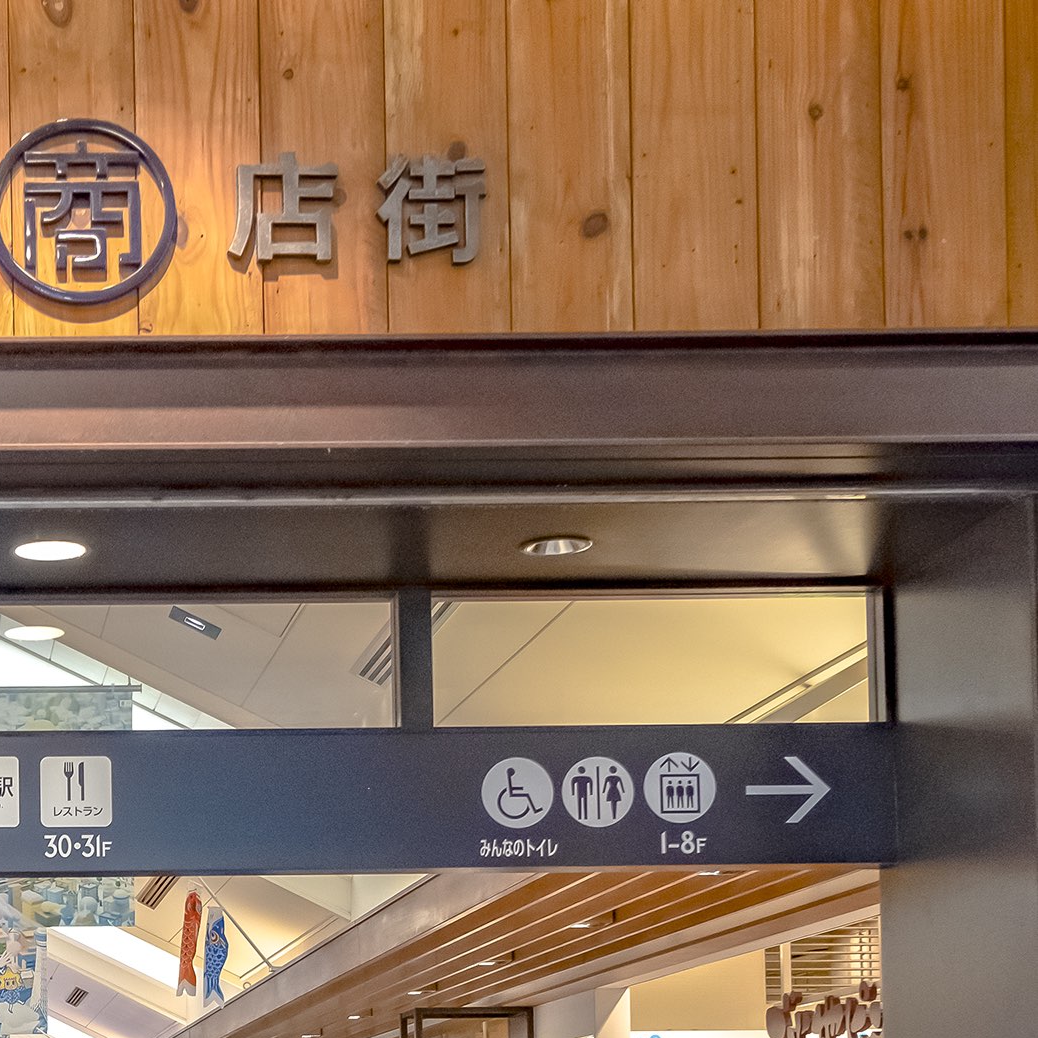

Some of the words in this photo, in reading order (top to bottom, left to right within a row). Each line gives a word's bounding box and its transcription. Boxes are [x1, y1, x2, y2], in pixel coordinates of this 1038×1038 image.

[53, 806, 103, 817] レストラン
[479, 838, 558, 858] みんなのトイレ
[660, 831, 707, 855] 1-8F
